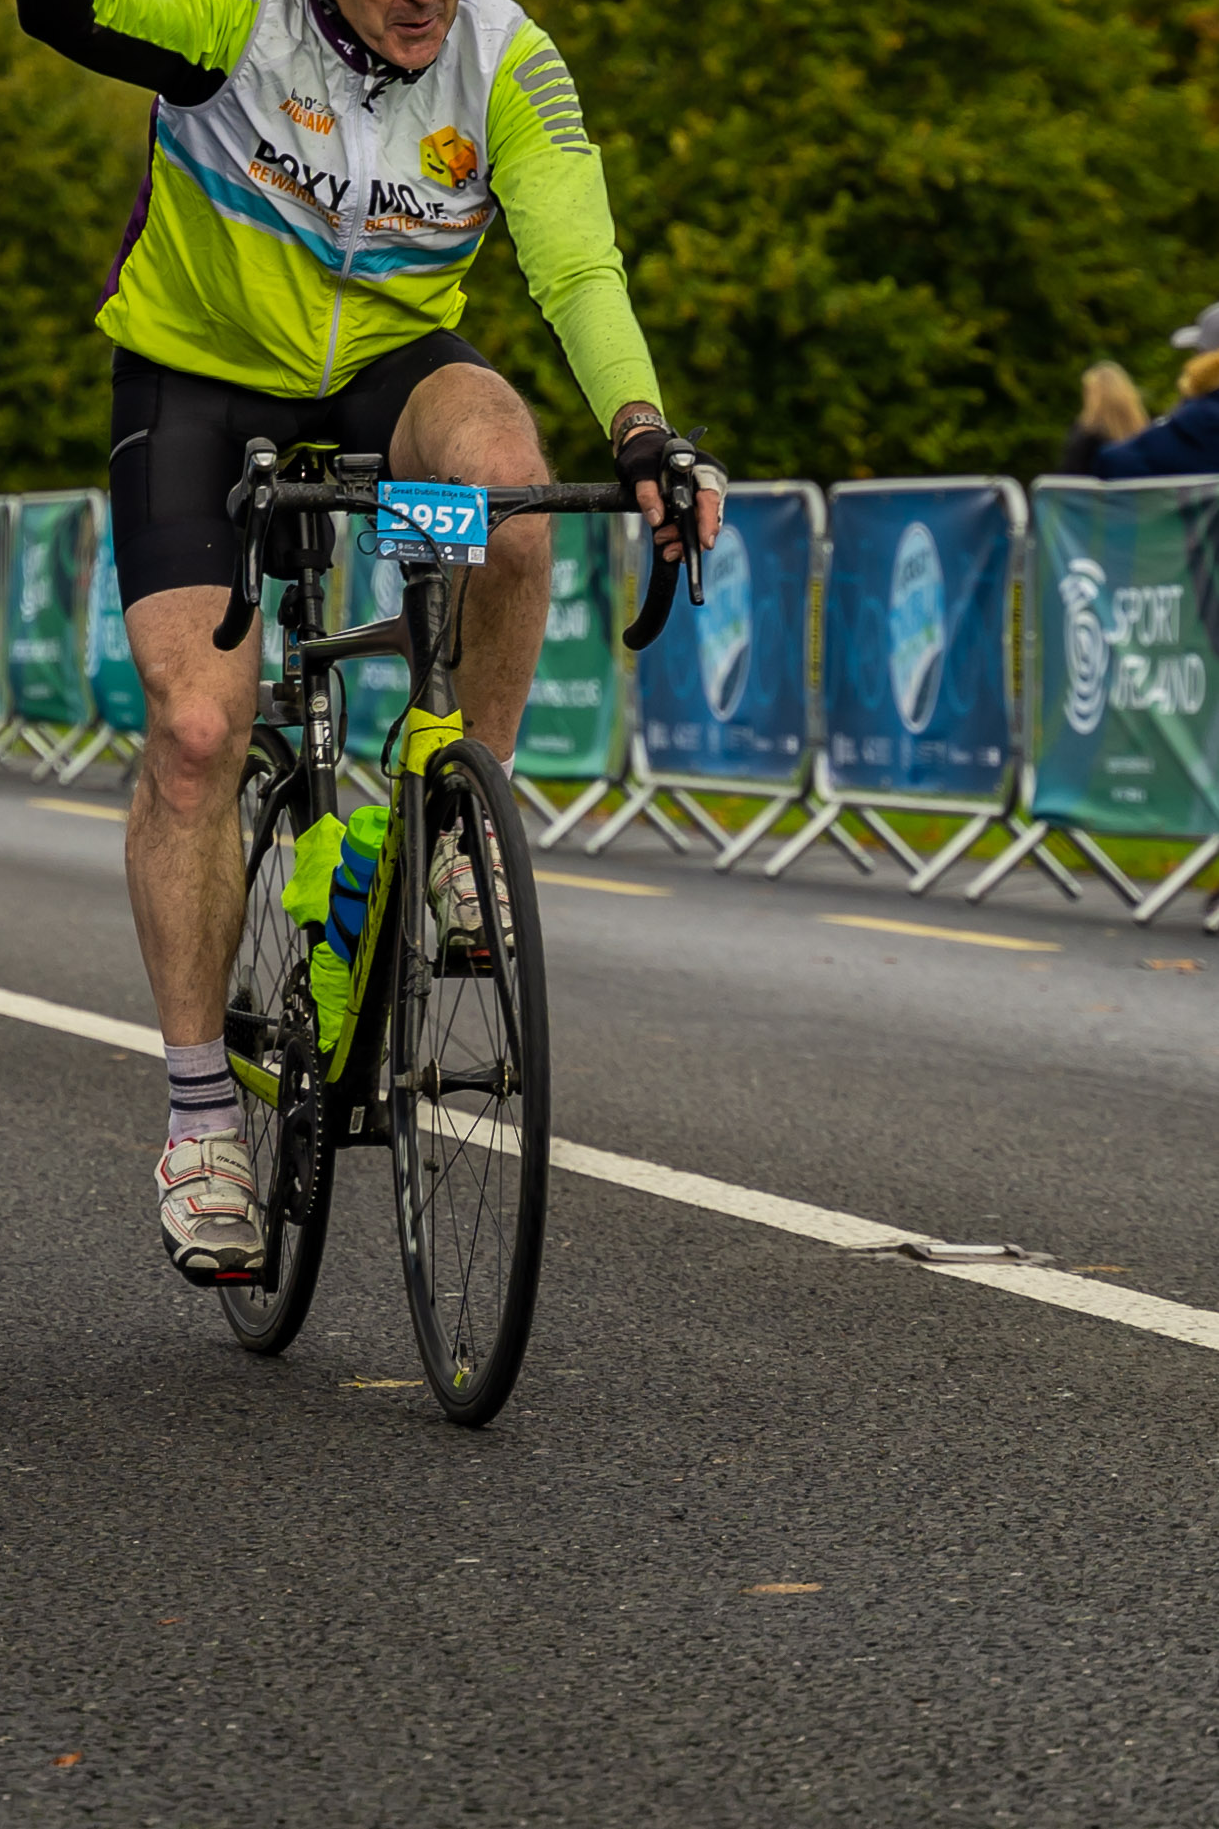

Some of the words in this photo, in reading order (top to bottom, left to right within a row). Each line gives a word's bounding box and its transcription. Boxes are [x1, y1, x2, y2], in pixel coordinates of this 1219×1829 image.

[248, 160, 341, 229] REWARDG
[391, 487, 413, 495] Great
[415, 488, 440, 497] Dublin
[441, 490, 458, 500] Bike
[460, 491, 476, 499] Ride
[390, 503, 475, 535] 3957
